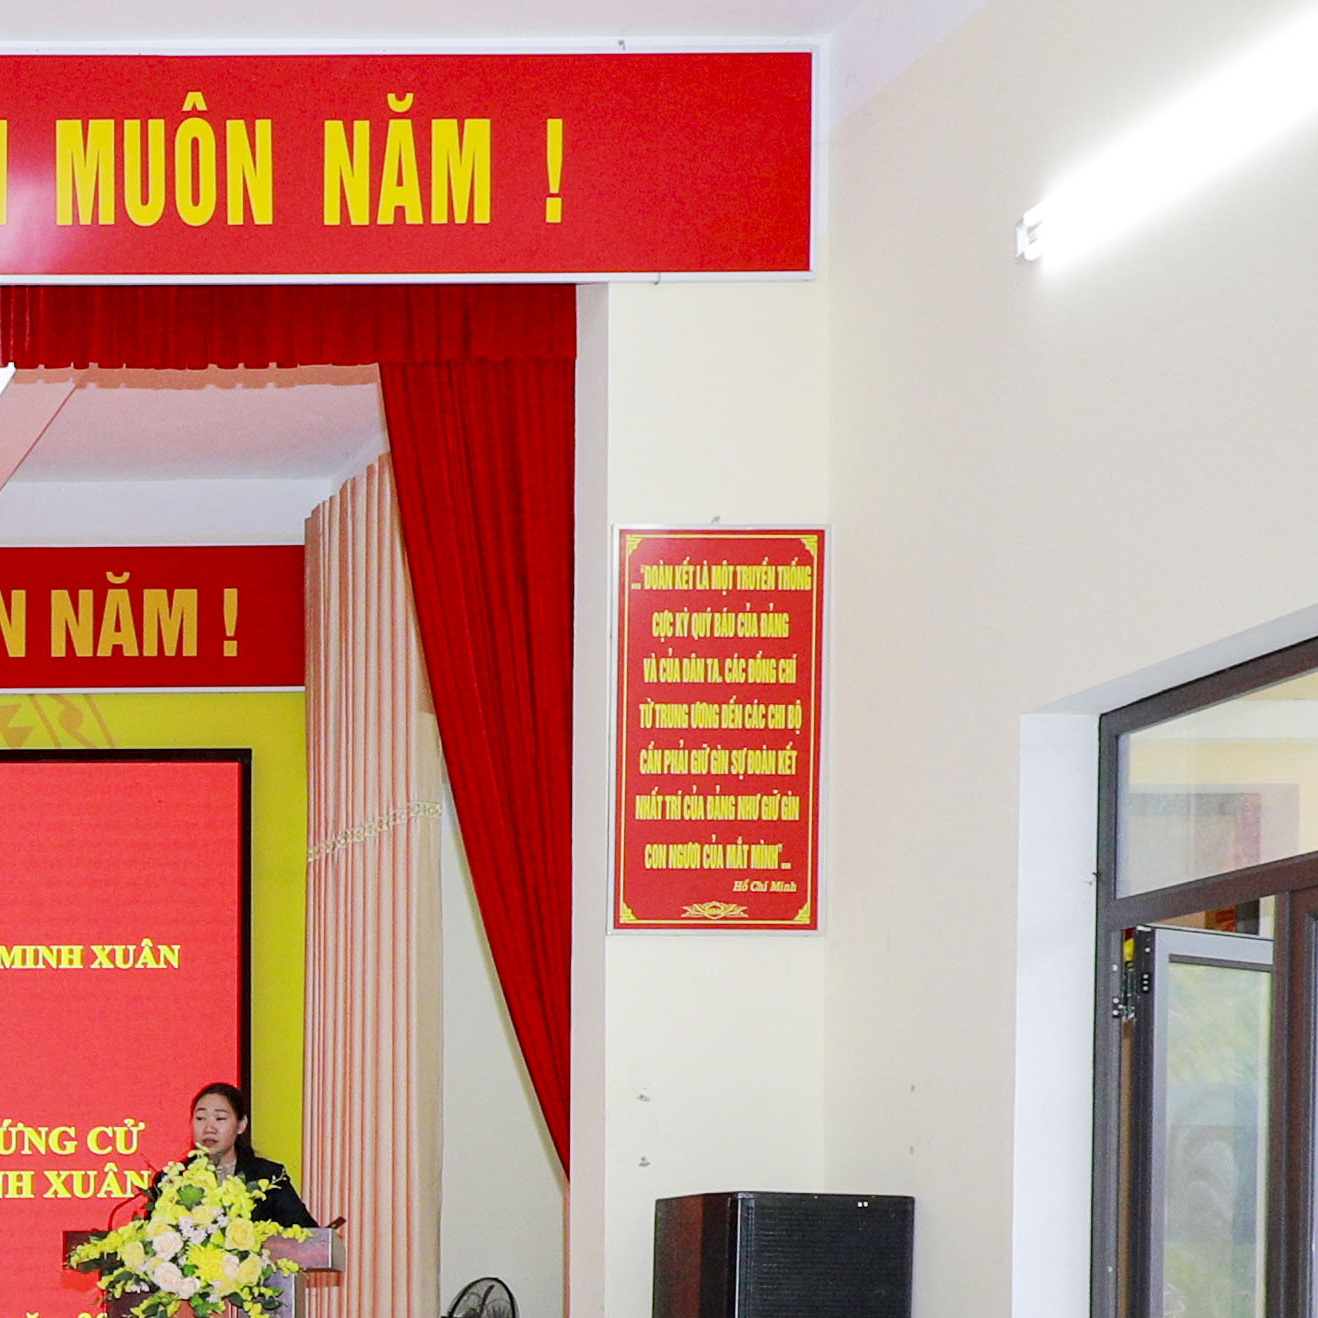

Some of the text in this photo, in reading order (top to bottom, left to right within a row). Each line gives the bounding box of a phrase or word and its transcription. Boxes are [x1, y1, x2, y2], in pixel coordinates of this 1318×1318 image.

[56, 92, 273, 226] MUÔN
[324, 93, 490, 225] NĂM
[675, 556, 694, 590] KẾT
[697, 559, 709, 591] LÀ
[52, 572, 197, 657] NĂM
[652, 609, 673, 643] CỰC
[691, 607, 712, 641] QUÝ
[738, 602, 758, 638] CỦA
[644, 652, 657, 683] VÀ
[659, 647, 680, 683] CỦA
[683, 652, 704, 684] DÂN
[725, 652, 746, 684] CÁC
[779, 653, 797, 684] CHÍ
[640, 697, 653, 729] TỪ
[656, 703, 688, 729] TRUNG
[745, 698, 766, 729] CÁC
[788, 699, 802, 735] BỘ
[664, 738, 688, 775] PHẢI
[778, 741, 797, 775] KẾT
[684, 784, 704, 821] CỦA
[645, 843, 666, 870] CON
[703, 833, 724, 870] CỦA
[770, 880, 796, 892] Minh
[89, 937, 181, 970] XUÂN
[86, 1118, 146, 1156] CỬ
[42, 1162, 152, 1199] XUÂN
